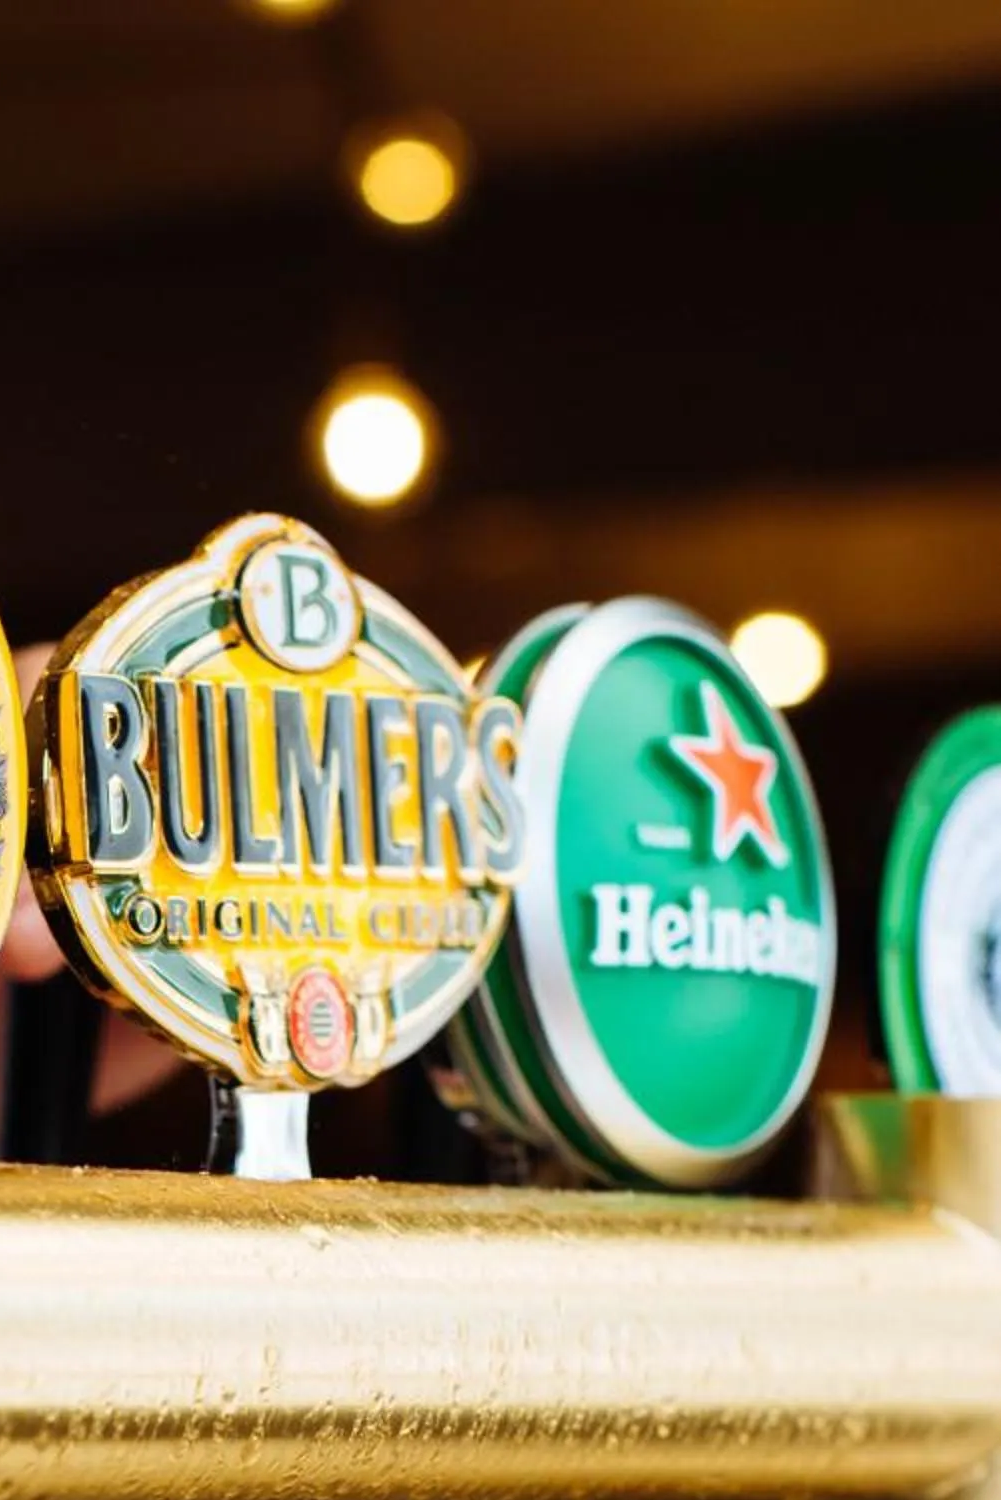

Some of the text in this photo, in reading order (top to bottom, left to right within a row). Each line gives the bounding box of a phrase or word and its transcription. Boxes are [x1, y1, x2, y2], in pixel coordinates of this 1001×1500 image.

[277, 554, 339, 649] B
[79, 674, 525, 884] BULMERS
[123, 892, 347, 945] ORIGINAL
[591, 882, 821, 988] Heineke
